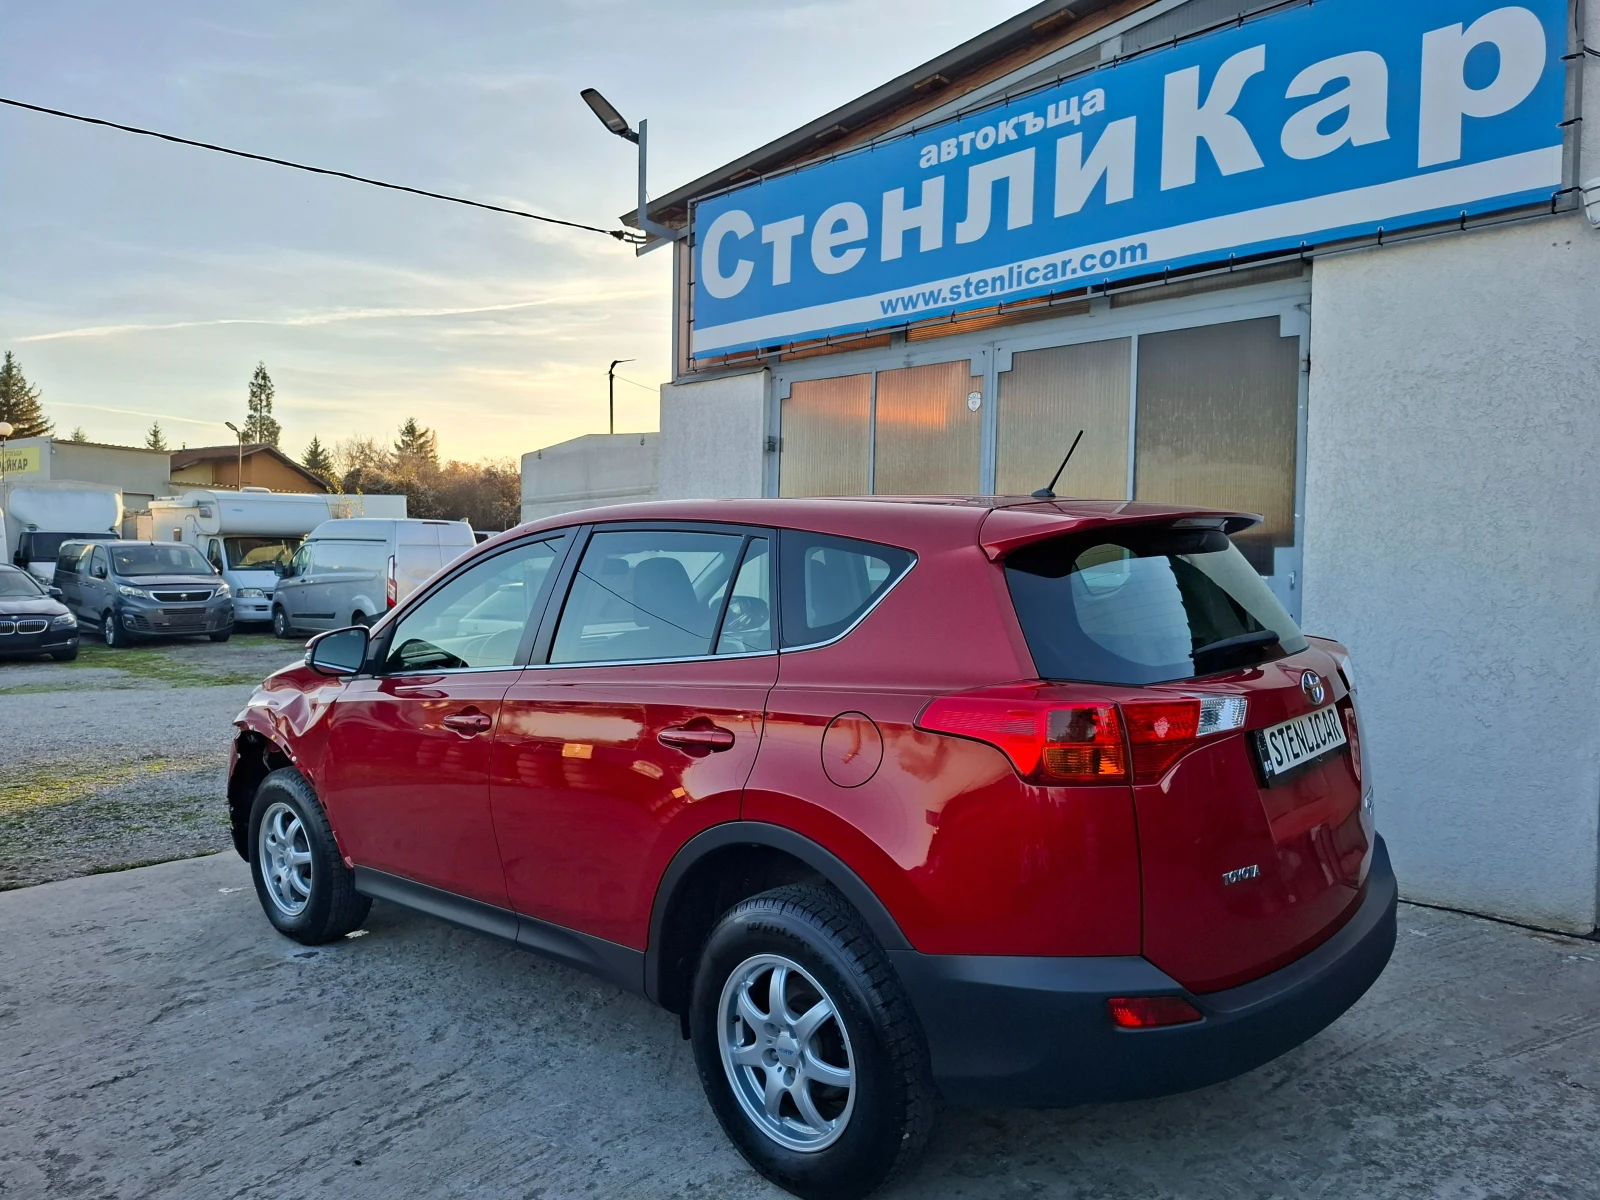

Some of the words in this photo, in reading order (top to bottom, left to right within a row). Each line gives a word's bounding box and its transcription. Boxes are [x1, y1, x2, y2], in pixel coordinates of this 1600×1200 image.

[701, 5, 1547, 299] СтенлиКар
[919, 88, 1105, 168] автокъща
[880, 242, 1147, 315] www.stenlicar.com
[1269, 708, 1342, 767] STENLICAR
[1222, 864, 1260, 885] TOYOTA
